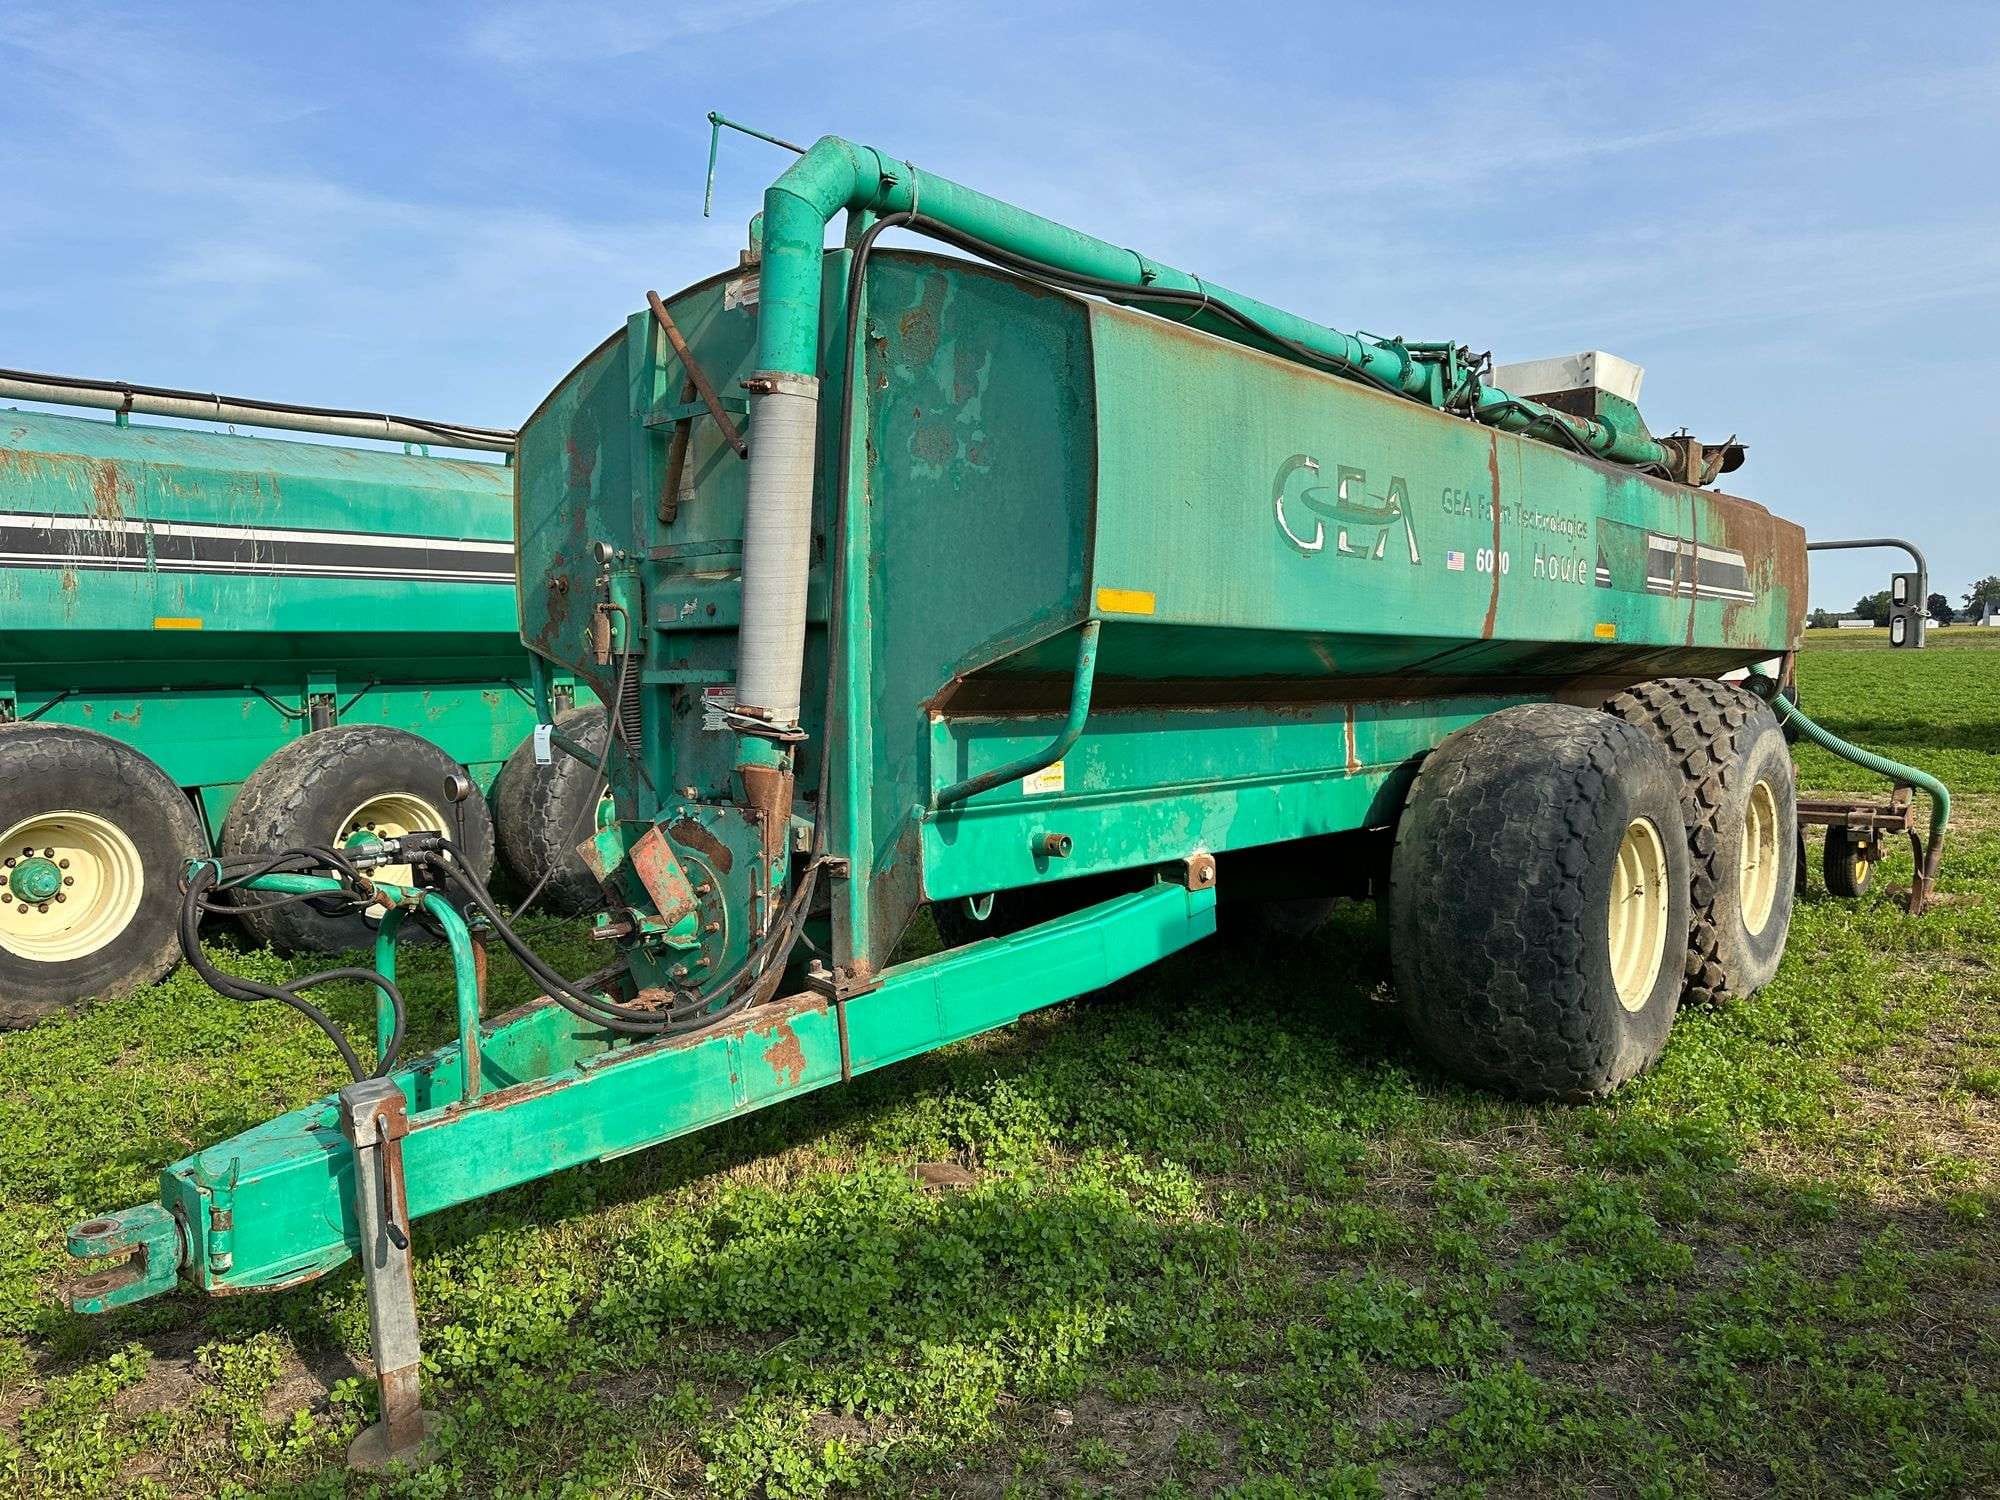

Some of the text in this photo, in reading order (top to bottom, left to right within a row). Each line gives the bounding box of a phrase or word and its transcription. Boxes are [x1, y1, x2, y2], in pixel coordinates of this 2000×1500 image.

[1273, 454, 1421, 565] GEA
[1442, 487, 1473, 518] GEA
[1478, 494, 1511, 526] Fam
[1533, 543, 1588, 585] Houle
